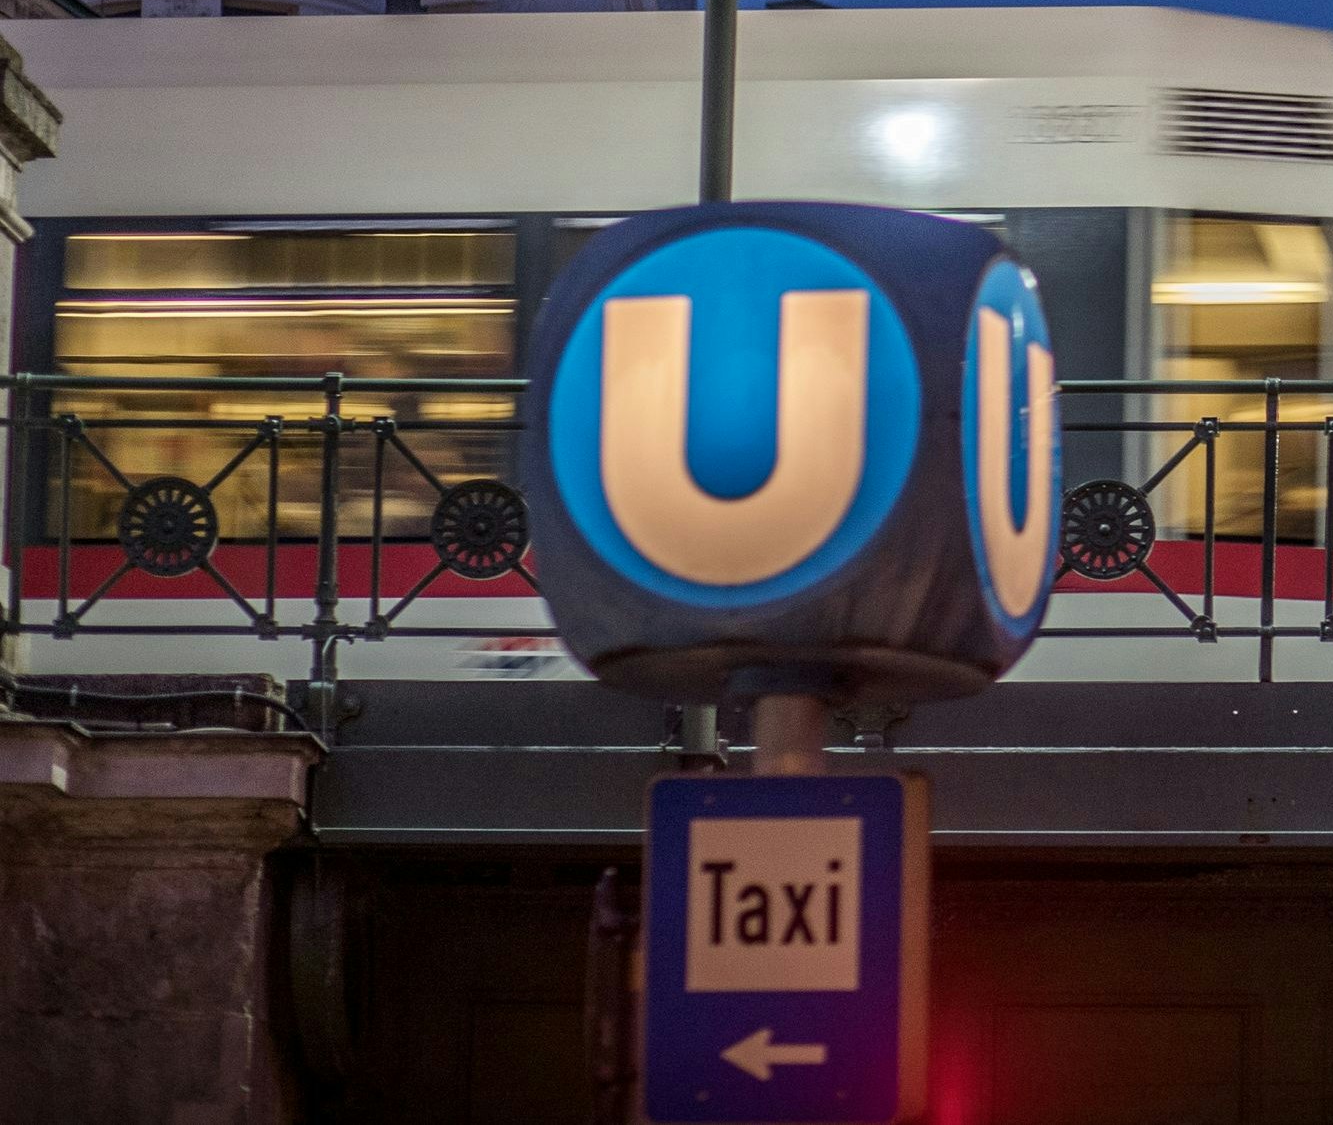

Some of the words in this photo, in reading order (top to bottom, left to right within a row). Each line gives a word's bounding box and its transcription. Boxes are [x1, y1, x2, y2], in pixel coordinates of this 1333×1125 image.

[601, 288, 871, 587] U
[977, 307, 1055, 619] U
[701, 859, 843, 946] Taxi
